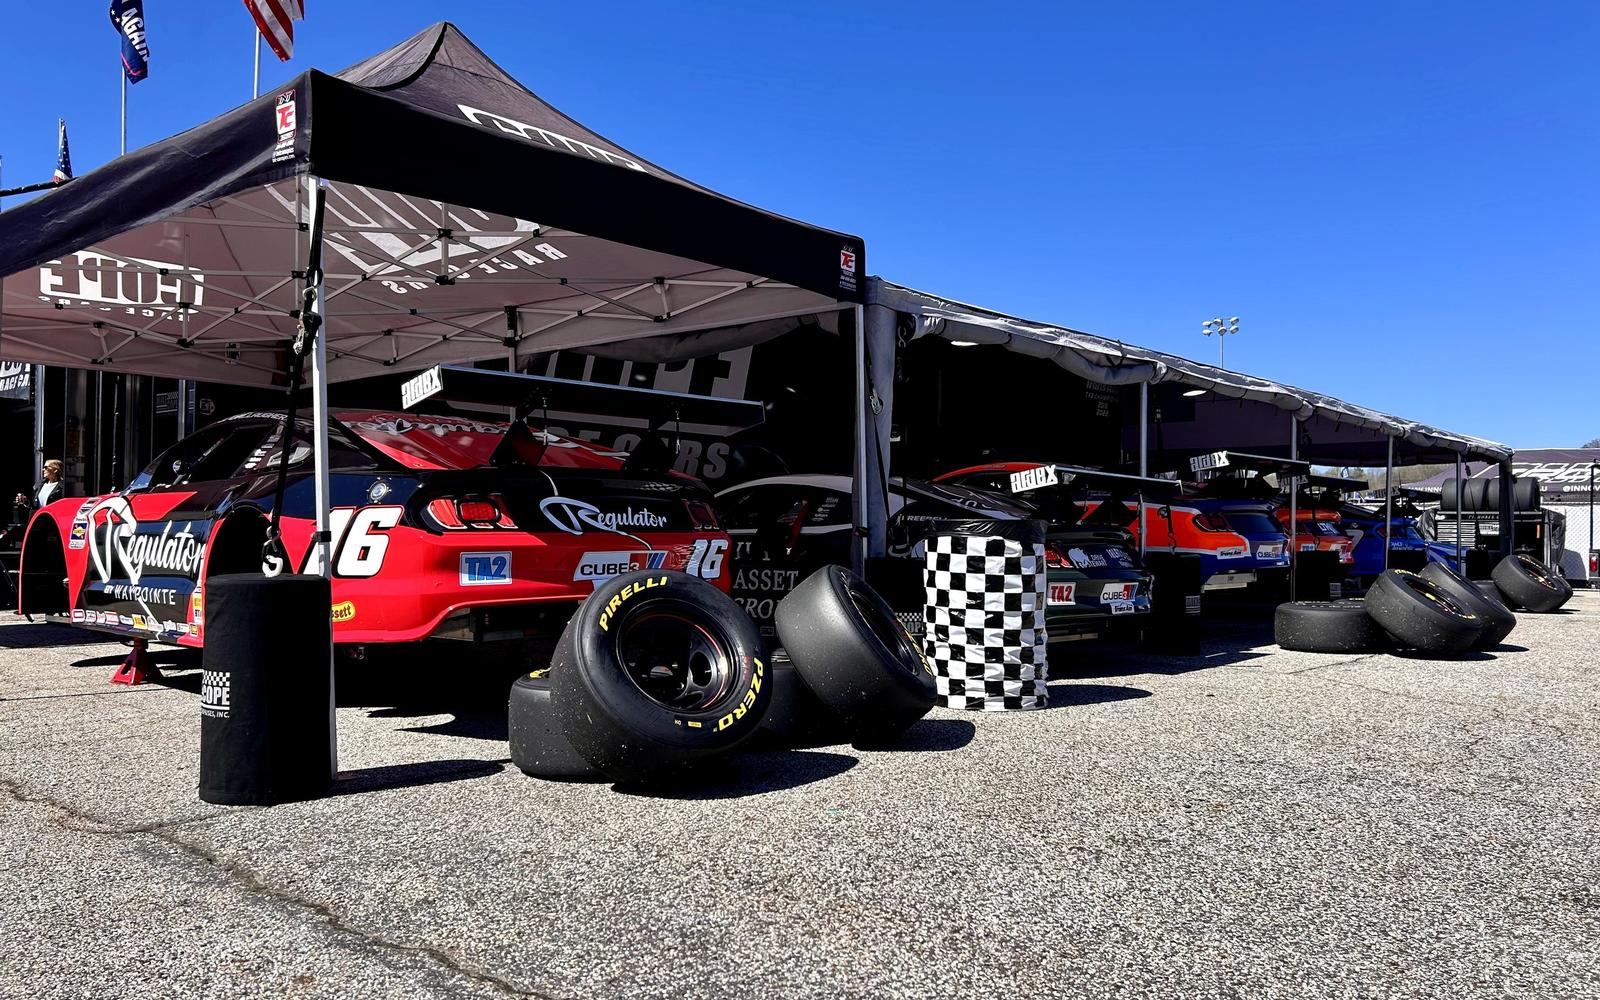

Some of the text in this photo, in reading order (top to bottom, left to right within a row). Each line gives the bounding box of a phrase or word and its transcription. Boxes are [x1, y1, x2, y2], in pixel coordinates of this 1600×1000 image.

[539, 496, 668, 535] Regulator
[464, 556, 507, 581] TA2
[733, 569, 798, 591] ASSET
[115, 584, 177, 605] WAYPOINTE
[600, 576, 668, 631] PIRELLI
[1051, 585, 1073, 602] TA2
[1102, 591, 1128, 601] CUBE3
